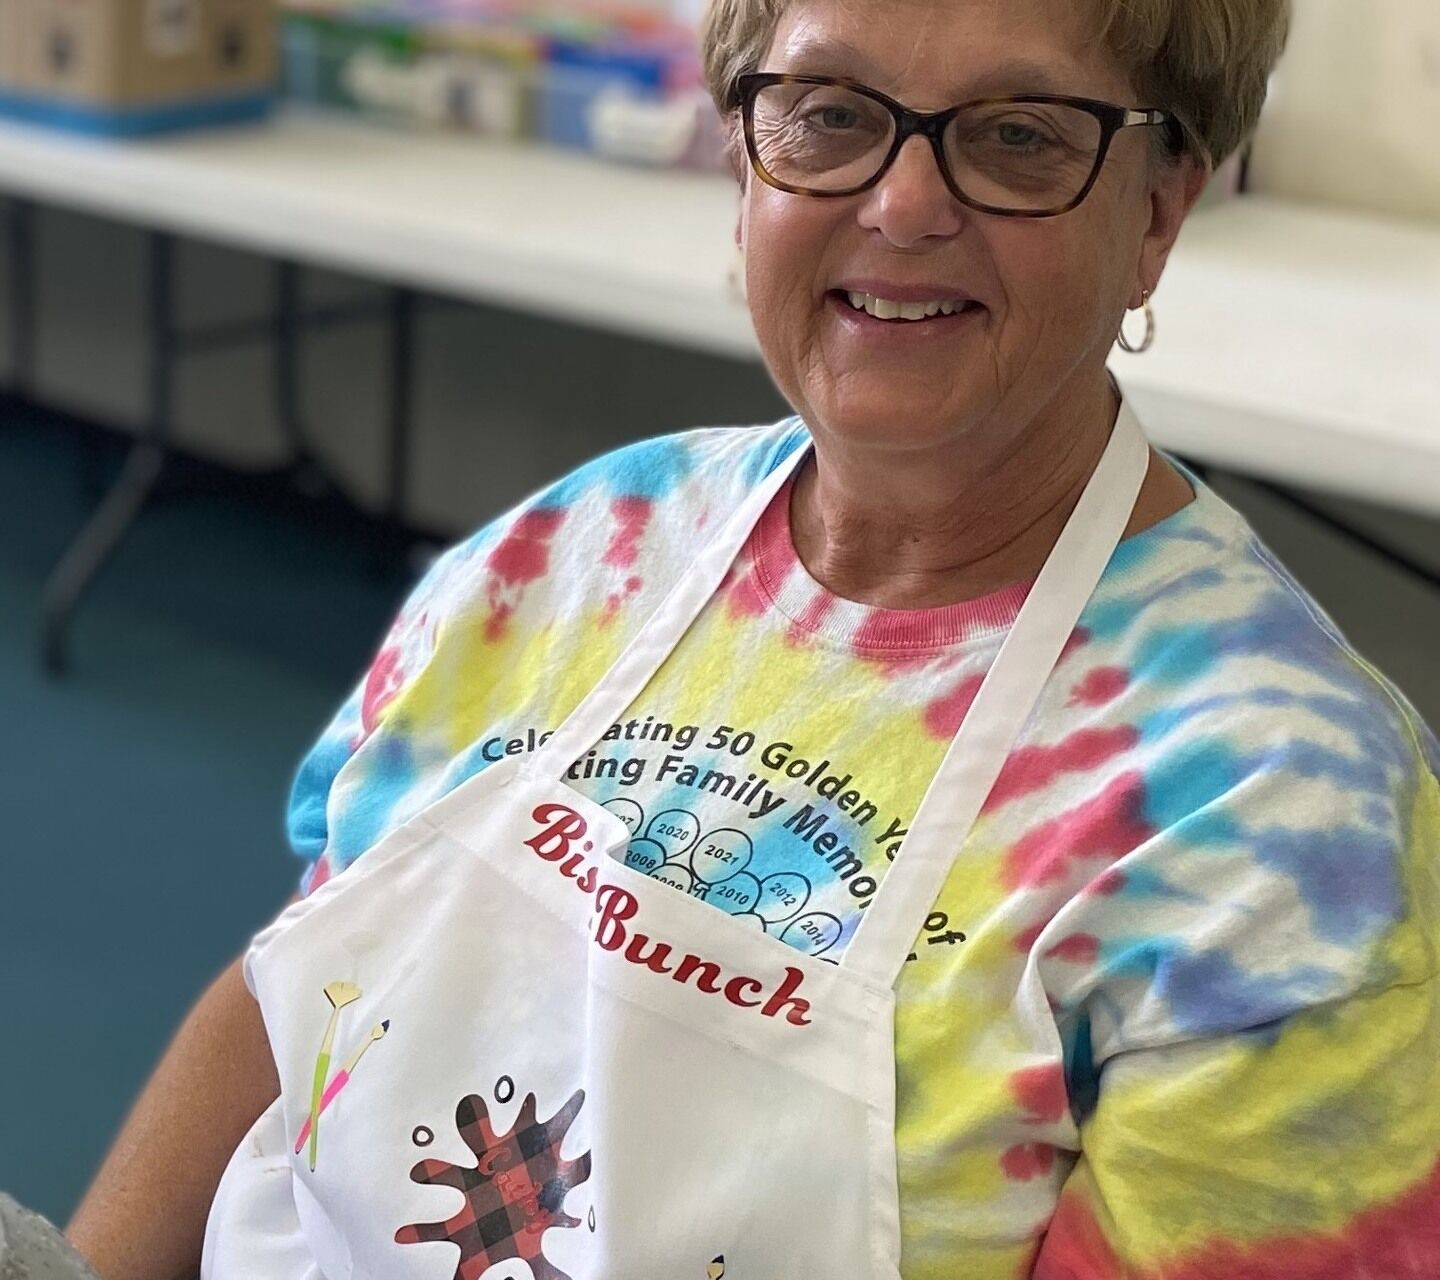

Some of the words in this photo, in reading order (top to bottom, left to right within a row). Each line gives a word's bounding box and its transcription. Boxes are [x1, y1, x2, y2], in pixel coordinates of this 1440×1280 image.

[655, 754, 788, 820] Family
[657, 823, 690, 842] 2020
[705, 724, 756, 757] 50
[760, 741, 879, 827] Golden
[923, 911, 967, 945] of
[625, 849, 657, 870] 2008
[704, 844, 740, 866] 2021
[716, 885, 750, 905] 2010
[769, 881, 797, 908] 2012
[800, 919, 828, 947] 2014
[594, 884, 813, 1027] Bunch
